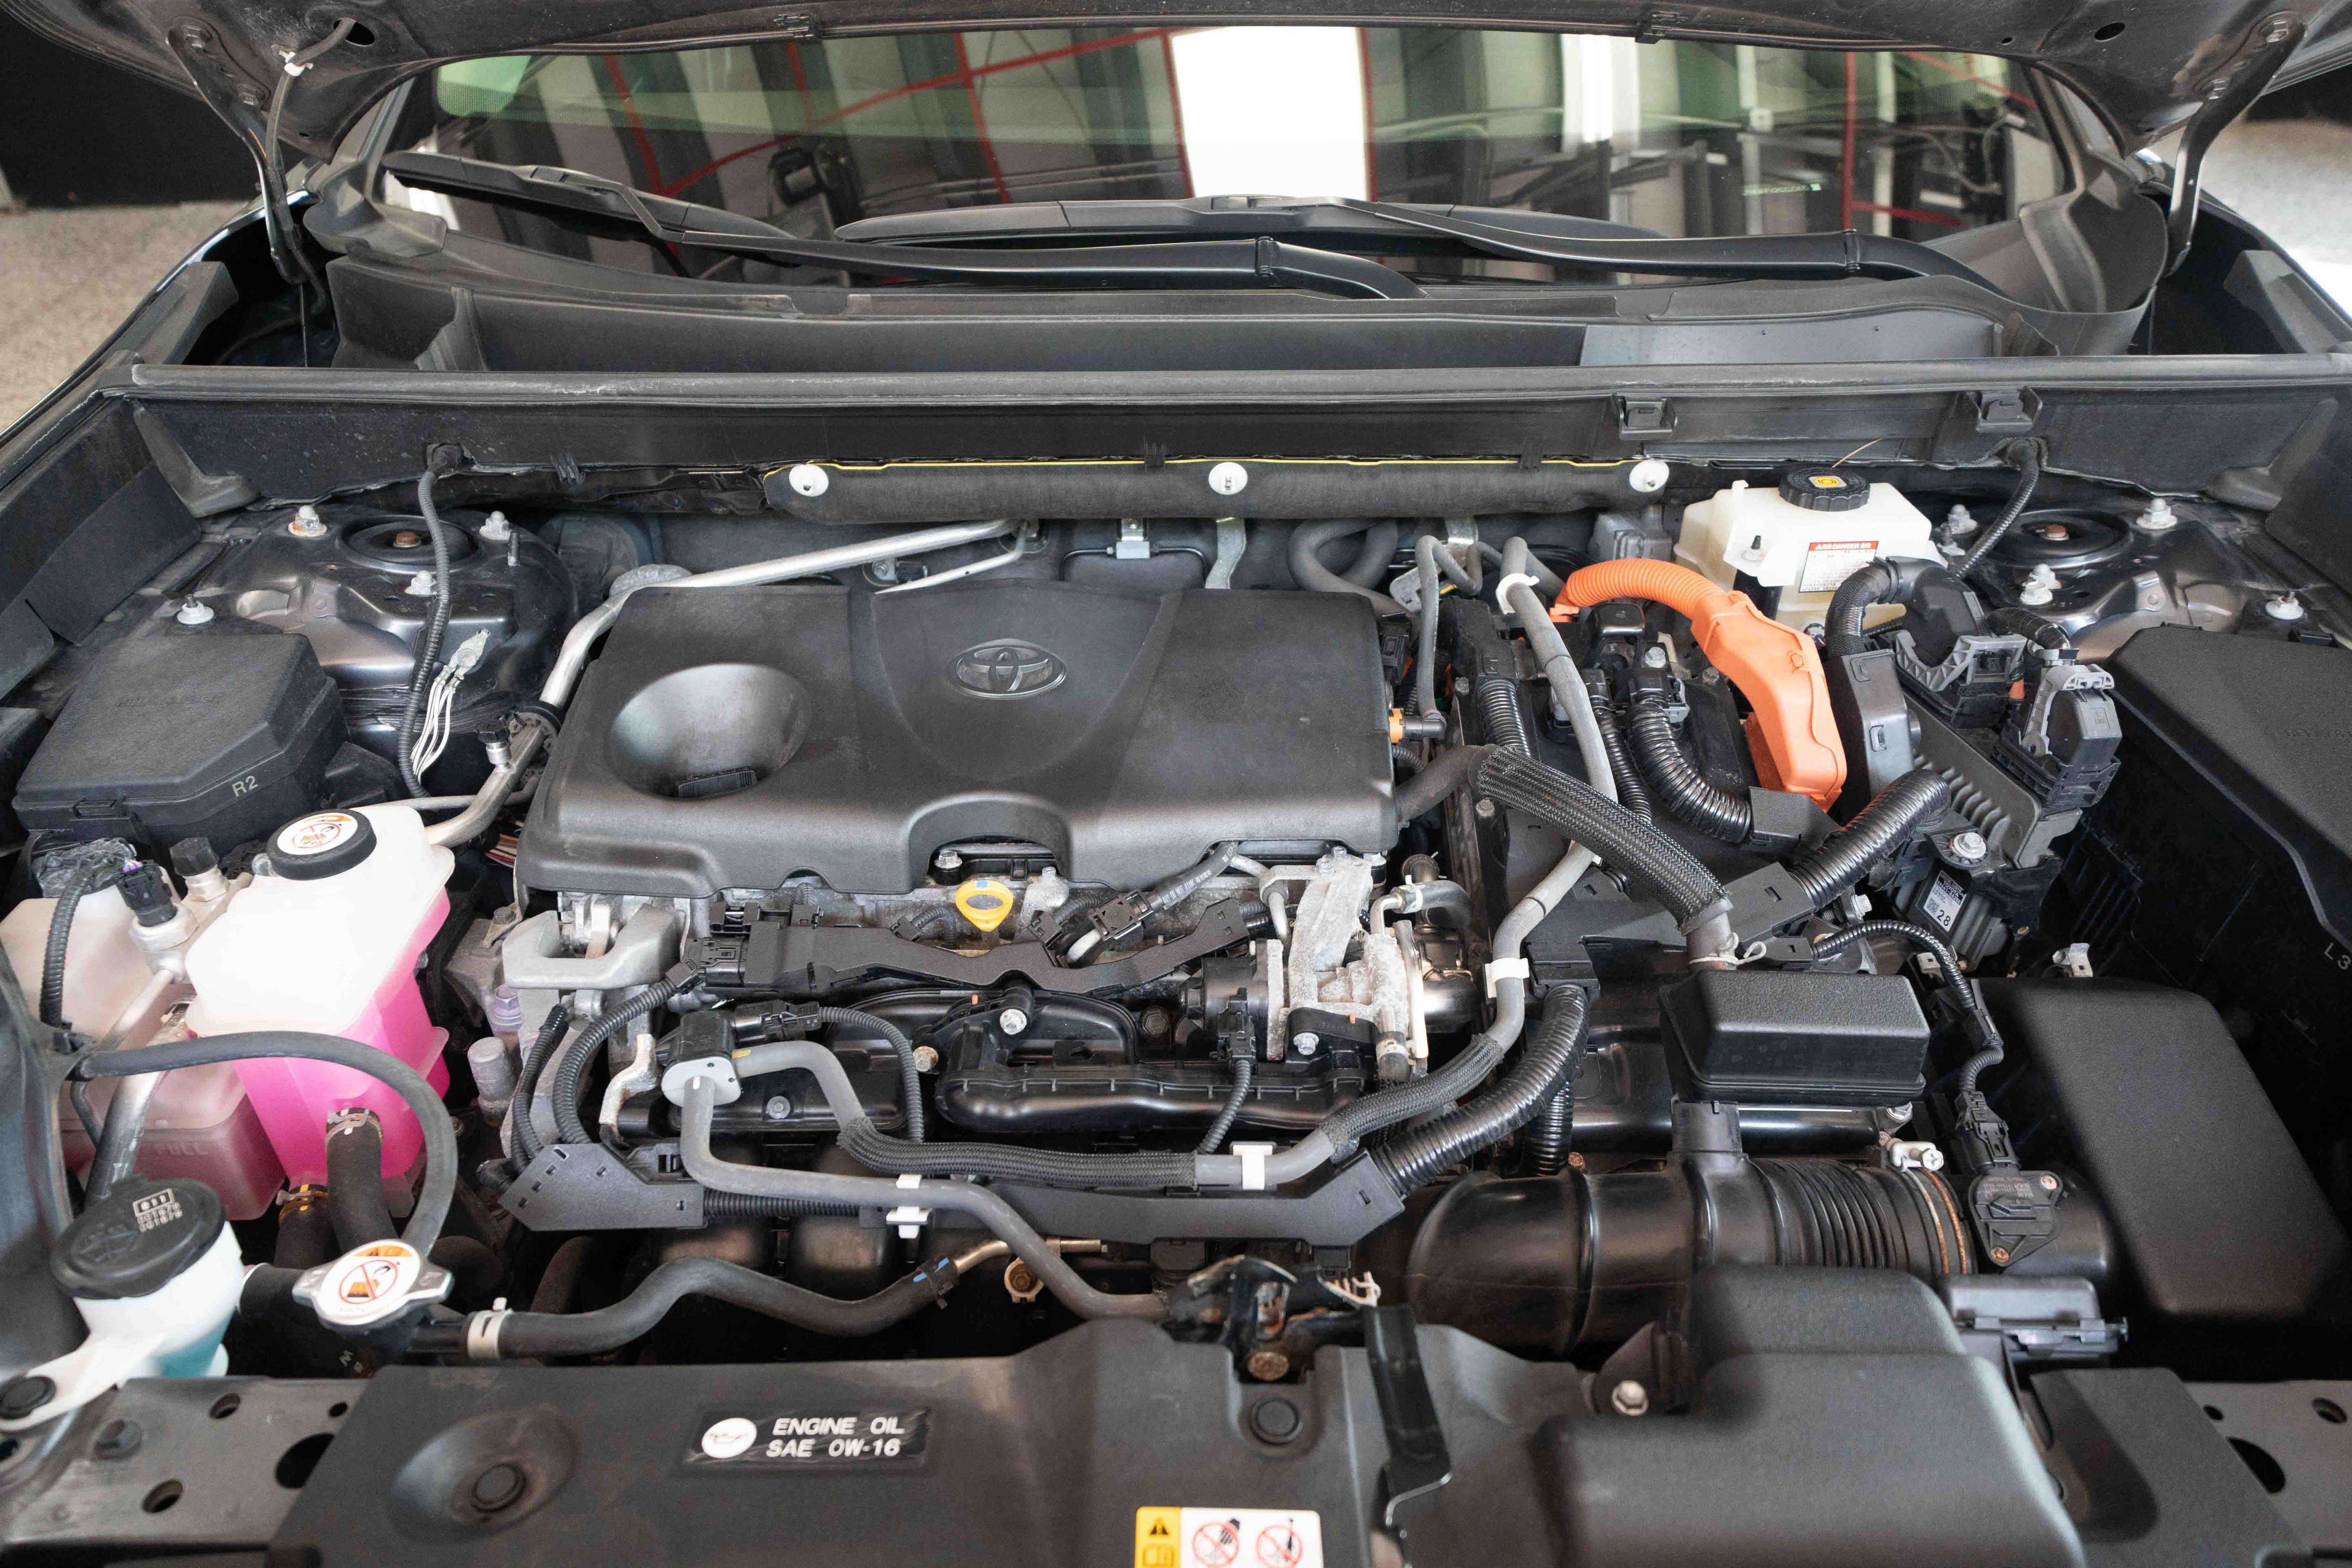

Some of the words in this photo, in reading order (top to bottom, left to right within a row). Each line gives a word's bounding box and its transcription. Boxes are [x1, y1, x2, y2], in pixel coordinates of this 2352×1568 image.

[232, 775, 258, 797] R2
[1936, 909, 1951, 927] 28
[2324, 942, 2351, 970] L3
[772, 1417, 857, 1436] ENGINE
[869, 1417, 905, 1435] OIL
[766, 1439, 816, 1458] SAE
[828, 1438, 901, 1457] 0W-16
